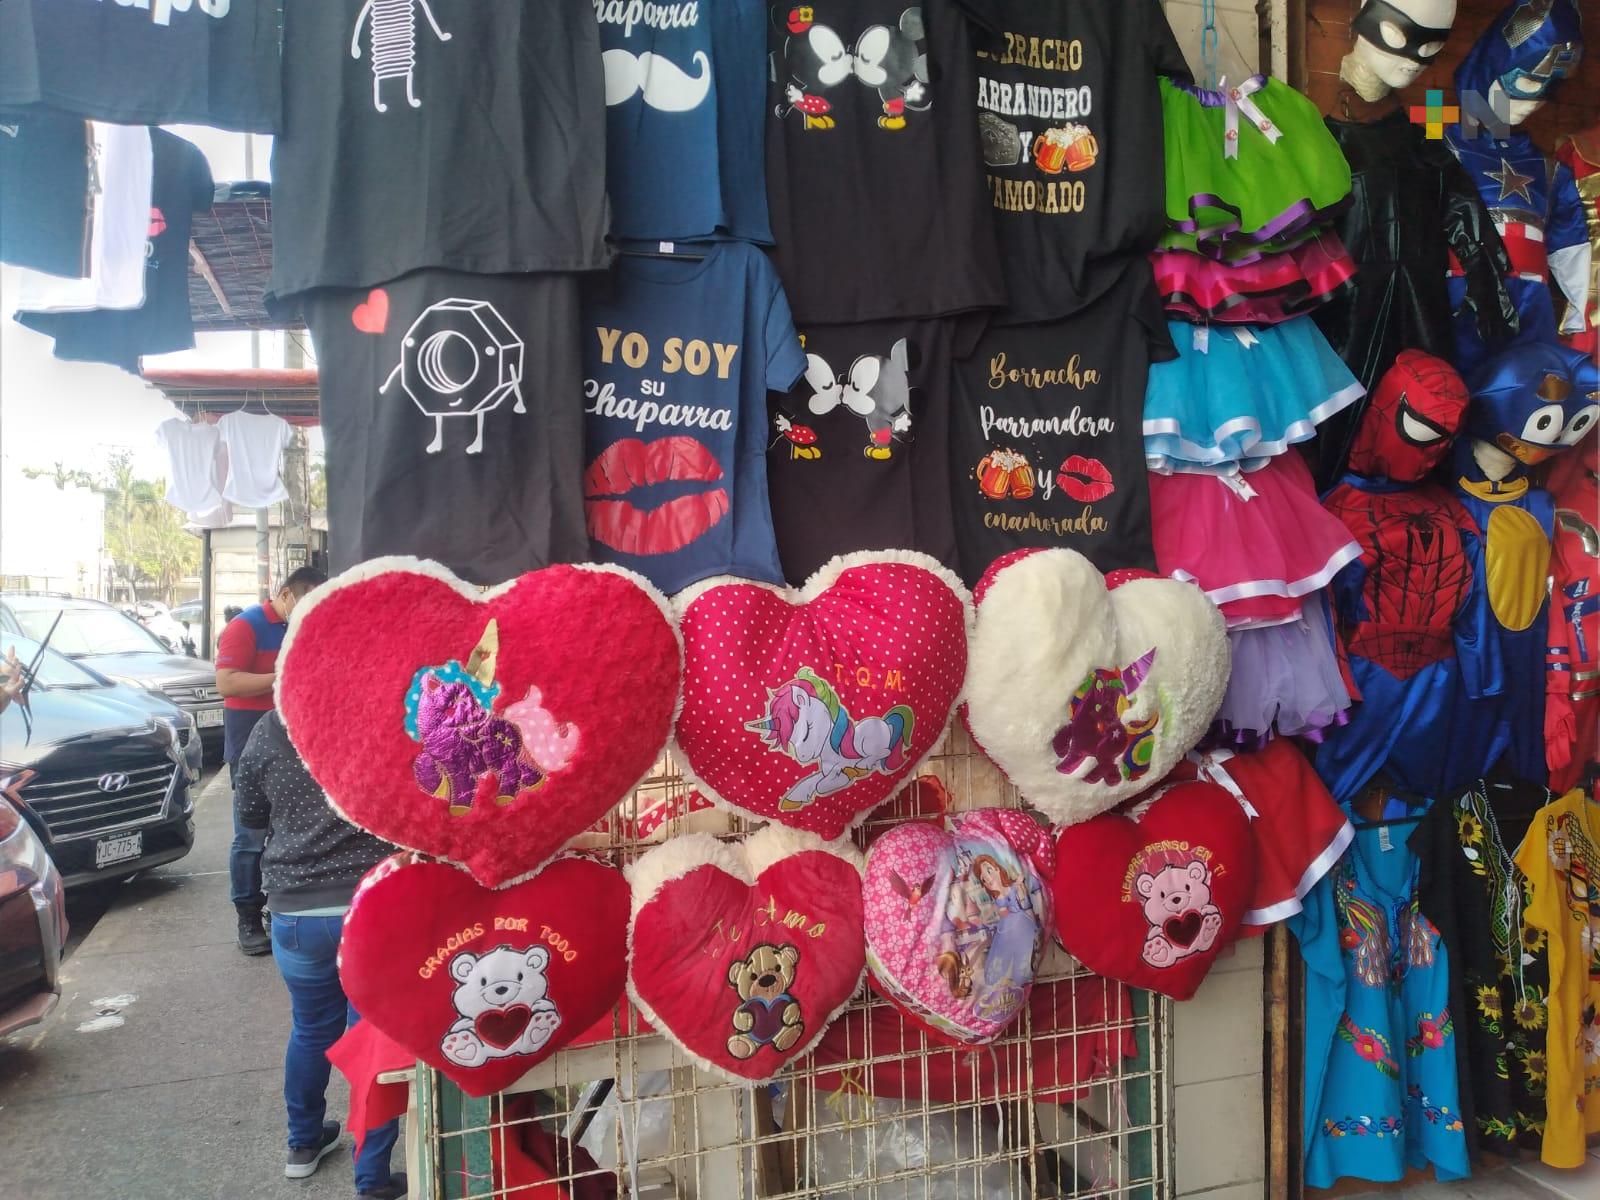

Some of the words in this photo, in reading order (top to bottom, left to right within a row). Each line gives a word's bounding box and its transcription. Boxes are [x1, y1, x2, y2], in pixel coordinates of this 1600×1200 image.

[976, 32, 1083, 72] RRACHO
[1019, 131, 1034, 163] Y
[597, 327, 649, 369] YO
[662, 338, 738, 379] SOY
[988, 352, 1101, 390] Borracha
[640, 379, 665, 397] SU
[980, 405, 1115, 440] Parrandera
[1037, 469, 1056, 500] y
[984, 505, 1109, 536] enamorada
[754, 894, 826, 938] Amo
[418, 922, 484, 979] GRACIAS
